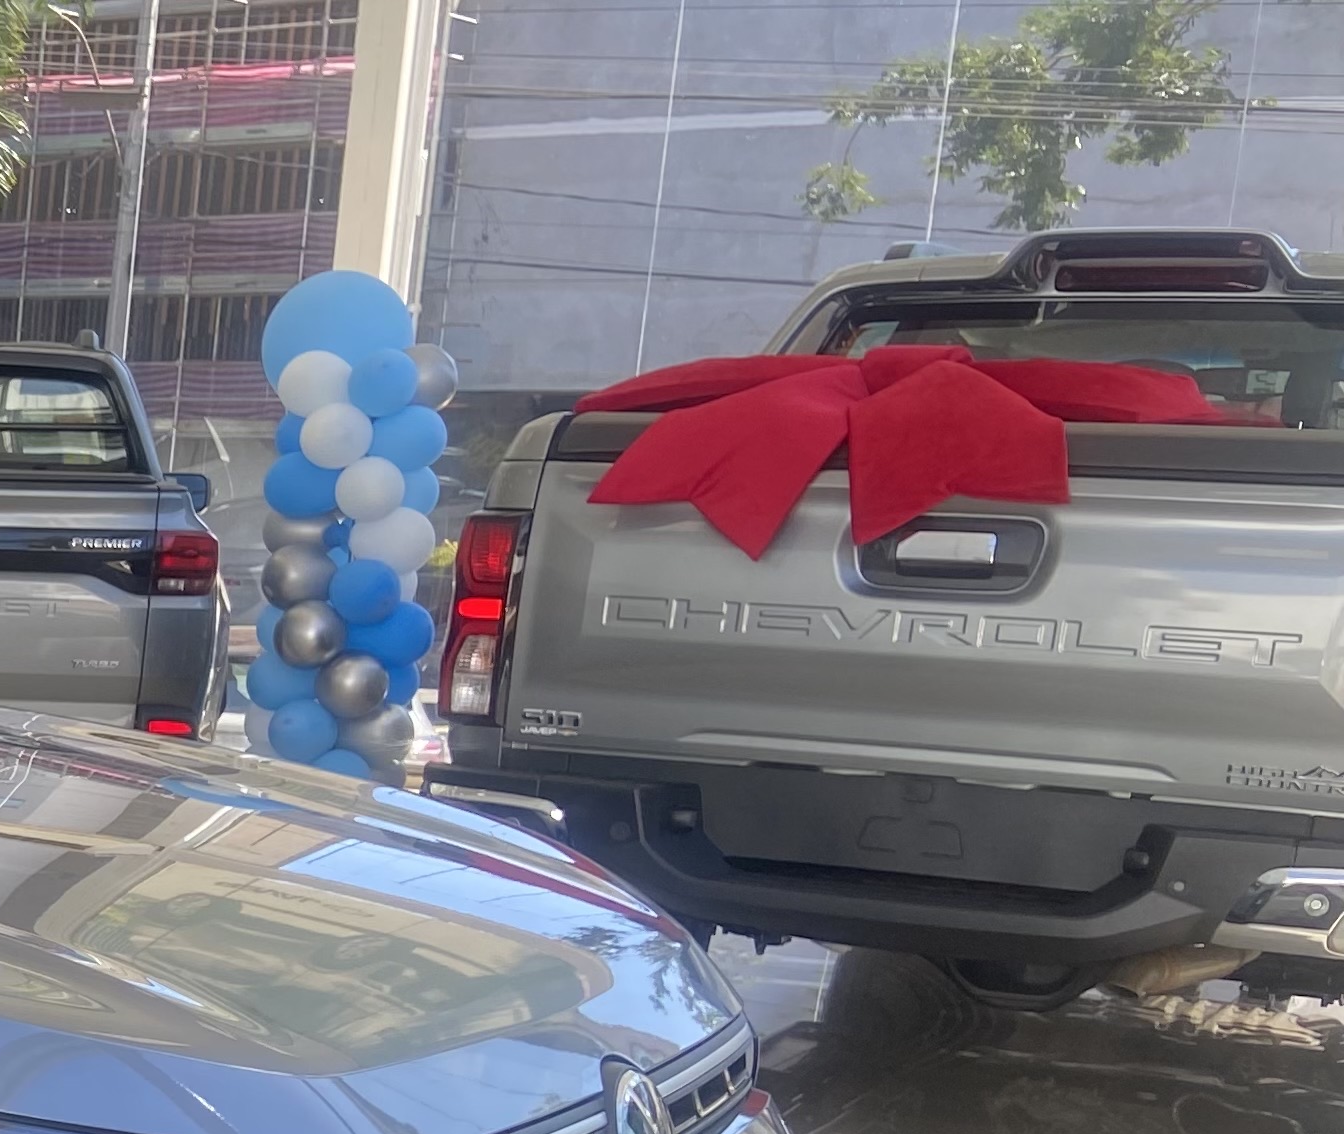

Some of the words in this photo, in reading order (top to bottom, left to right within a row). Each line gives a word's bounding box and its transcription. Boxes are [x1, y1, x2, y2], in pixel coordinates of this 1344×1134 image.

[70, 537, 143, 549] PREMIER
[602, 594, 1302, 667] CHEVROLET
[521, 708, 582, 728] S10
